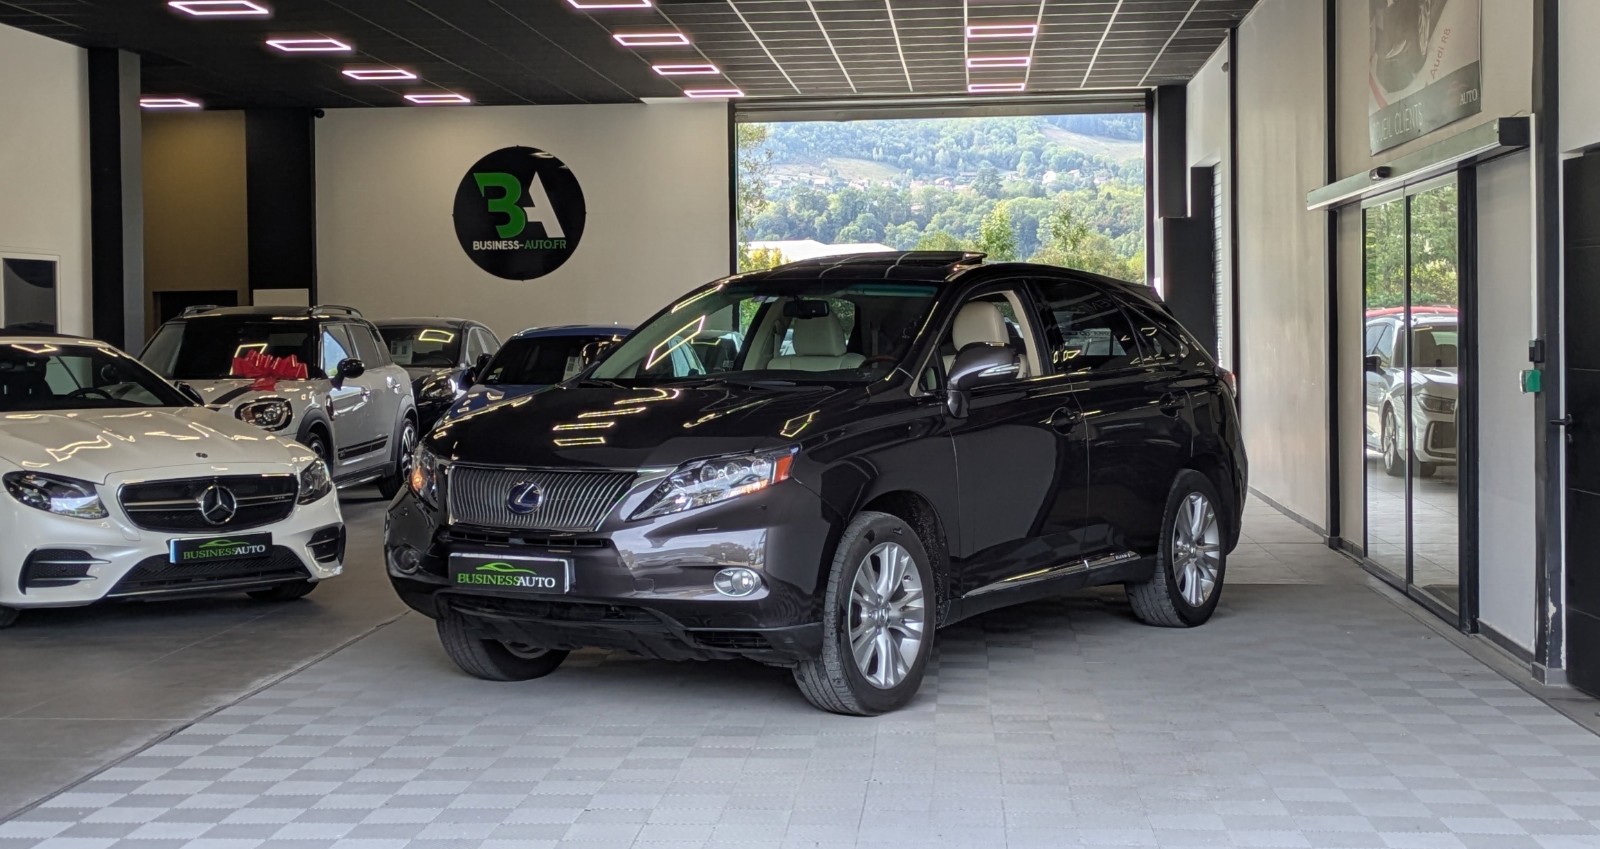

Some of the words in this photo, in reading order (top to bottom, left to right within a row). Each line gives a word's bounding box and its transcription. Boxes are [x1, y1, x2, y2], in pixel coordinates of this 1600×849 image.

[1430, 46, 1444, 80] Audi
[1459, 88, 1478, 106] AUTO
[1394, 102, 1424, 135] CLIENTS
[472, 239, 567, 251] BUSINESS-AUTO.FR
